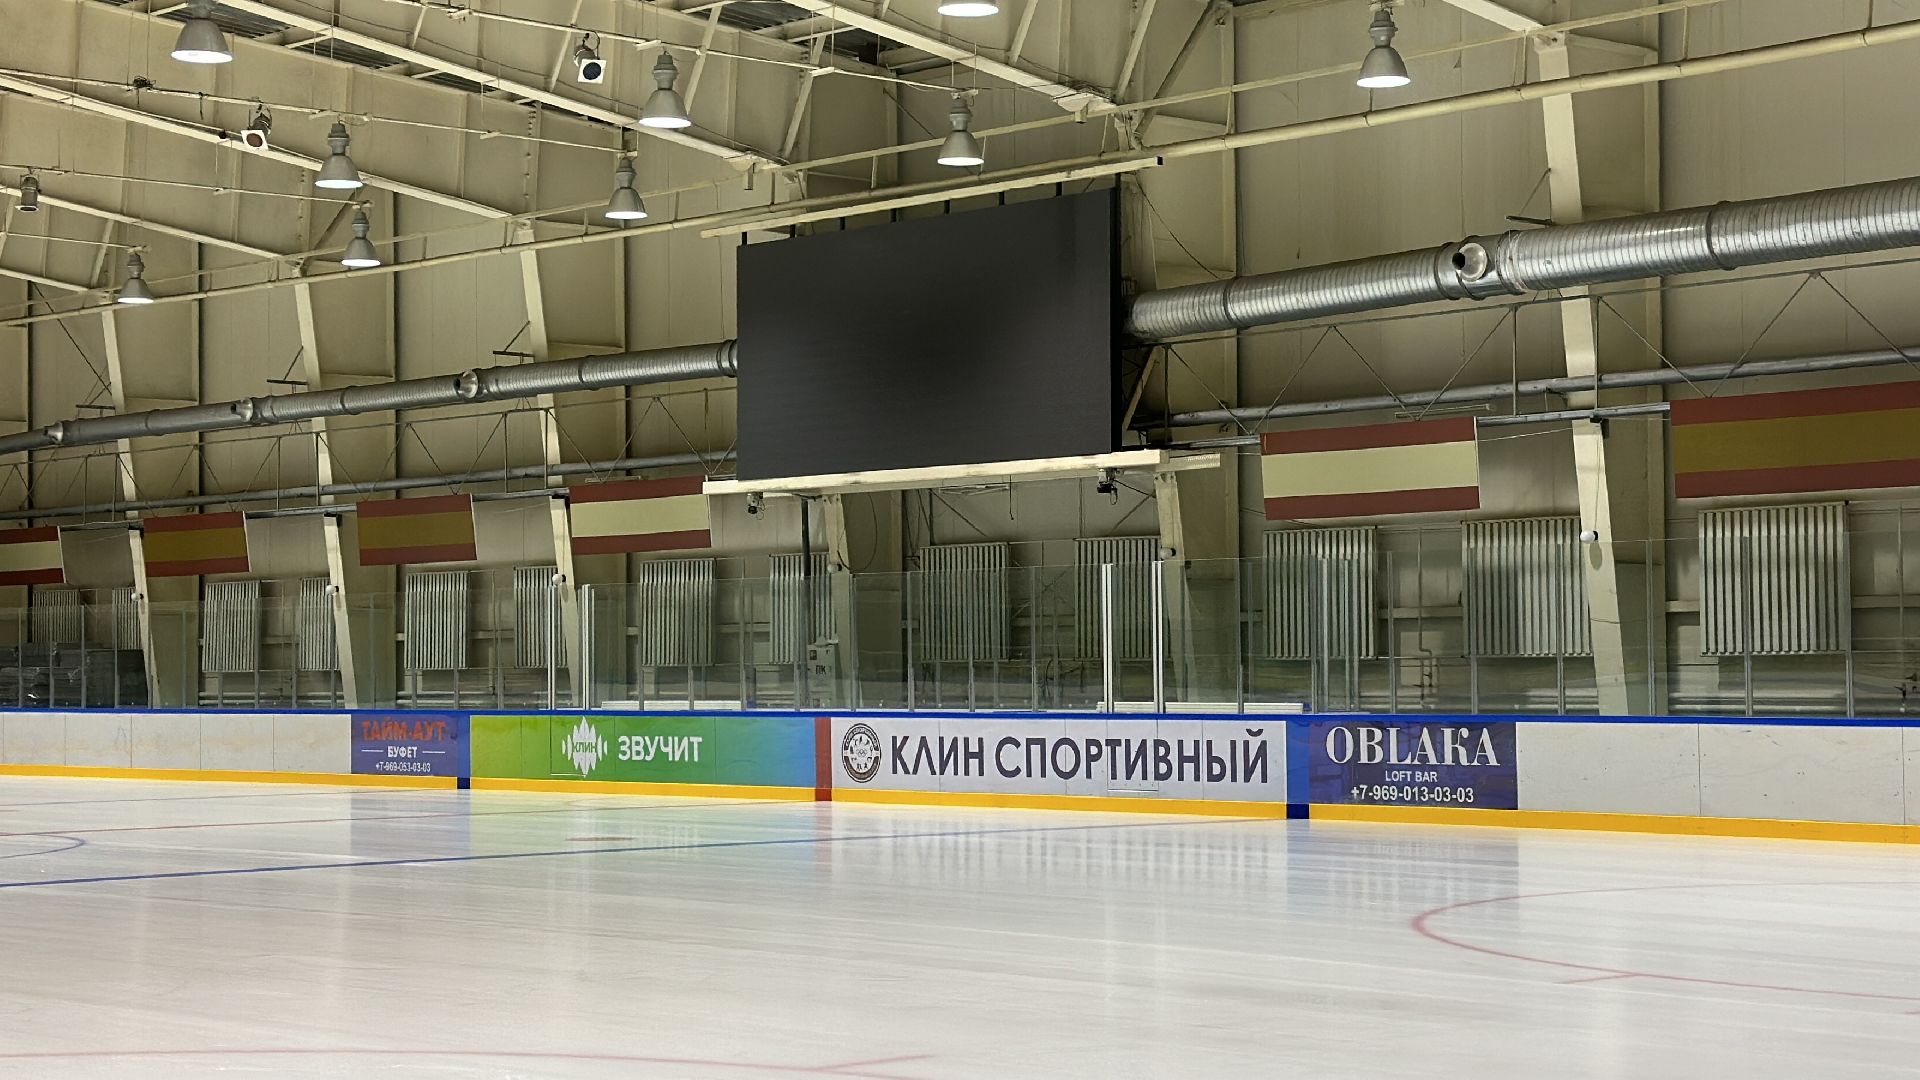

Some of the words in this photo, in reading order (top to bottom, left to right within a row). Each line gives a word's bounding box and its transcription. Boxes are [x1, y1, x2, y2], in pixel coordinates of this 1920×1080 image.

[362, 718, 446, 741] ТАЙМ-АУТ
[387, 746, 418, 758] БУФЕТ
[618, 735, 703, 762] ЗВУЧИТ
[891, 736, 984, 777] КЛИН
[994, 728, 1268, 784] СПОРТИВНЫЙ
[1325, 726, 1501, 766] OBLAKA
[1385, 770, 1412, 782] LOFT
[1415, 771, 1438, 782] BAR
[1351, 785, 1474, 802] +7-969-013-03-03
